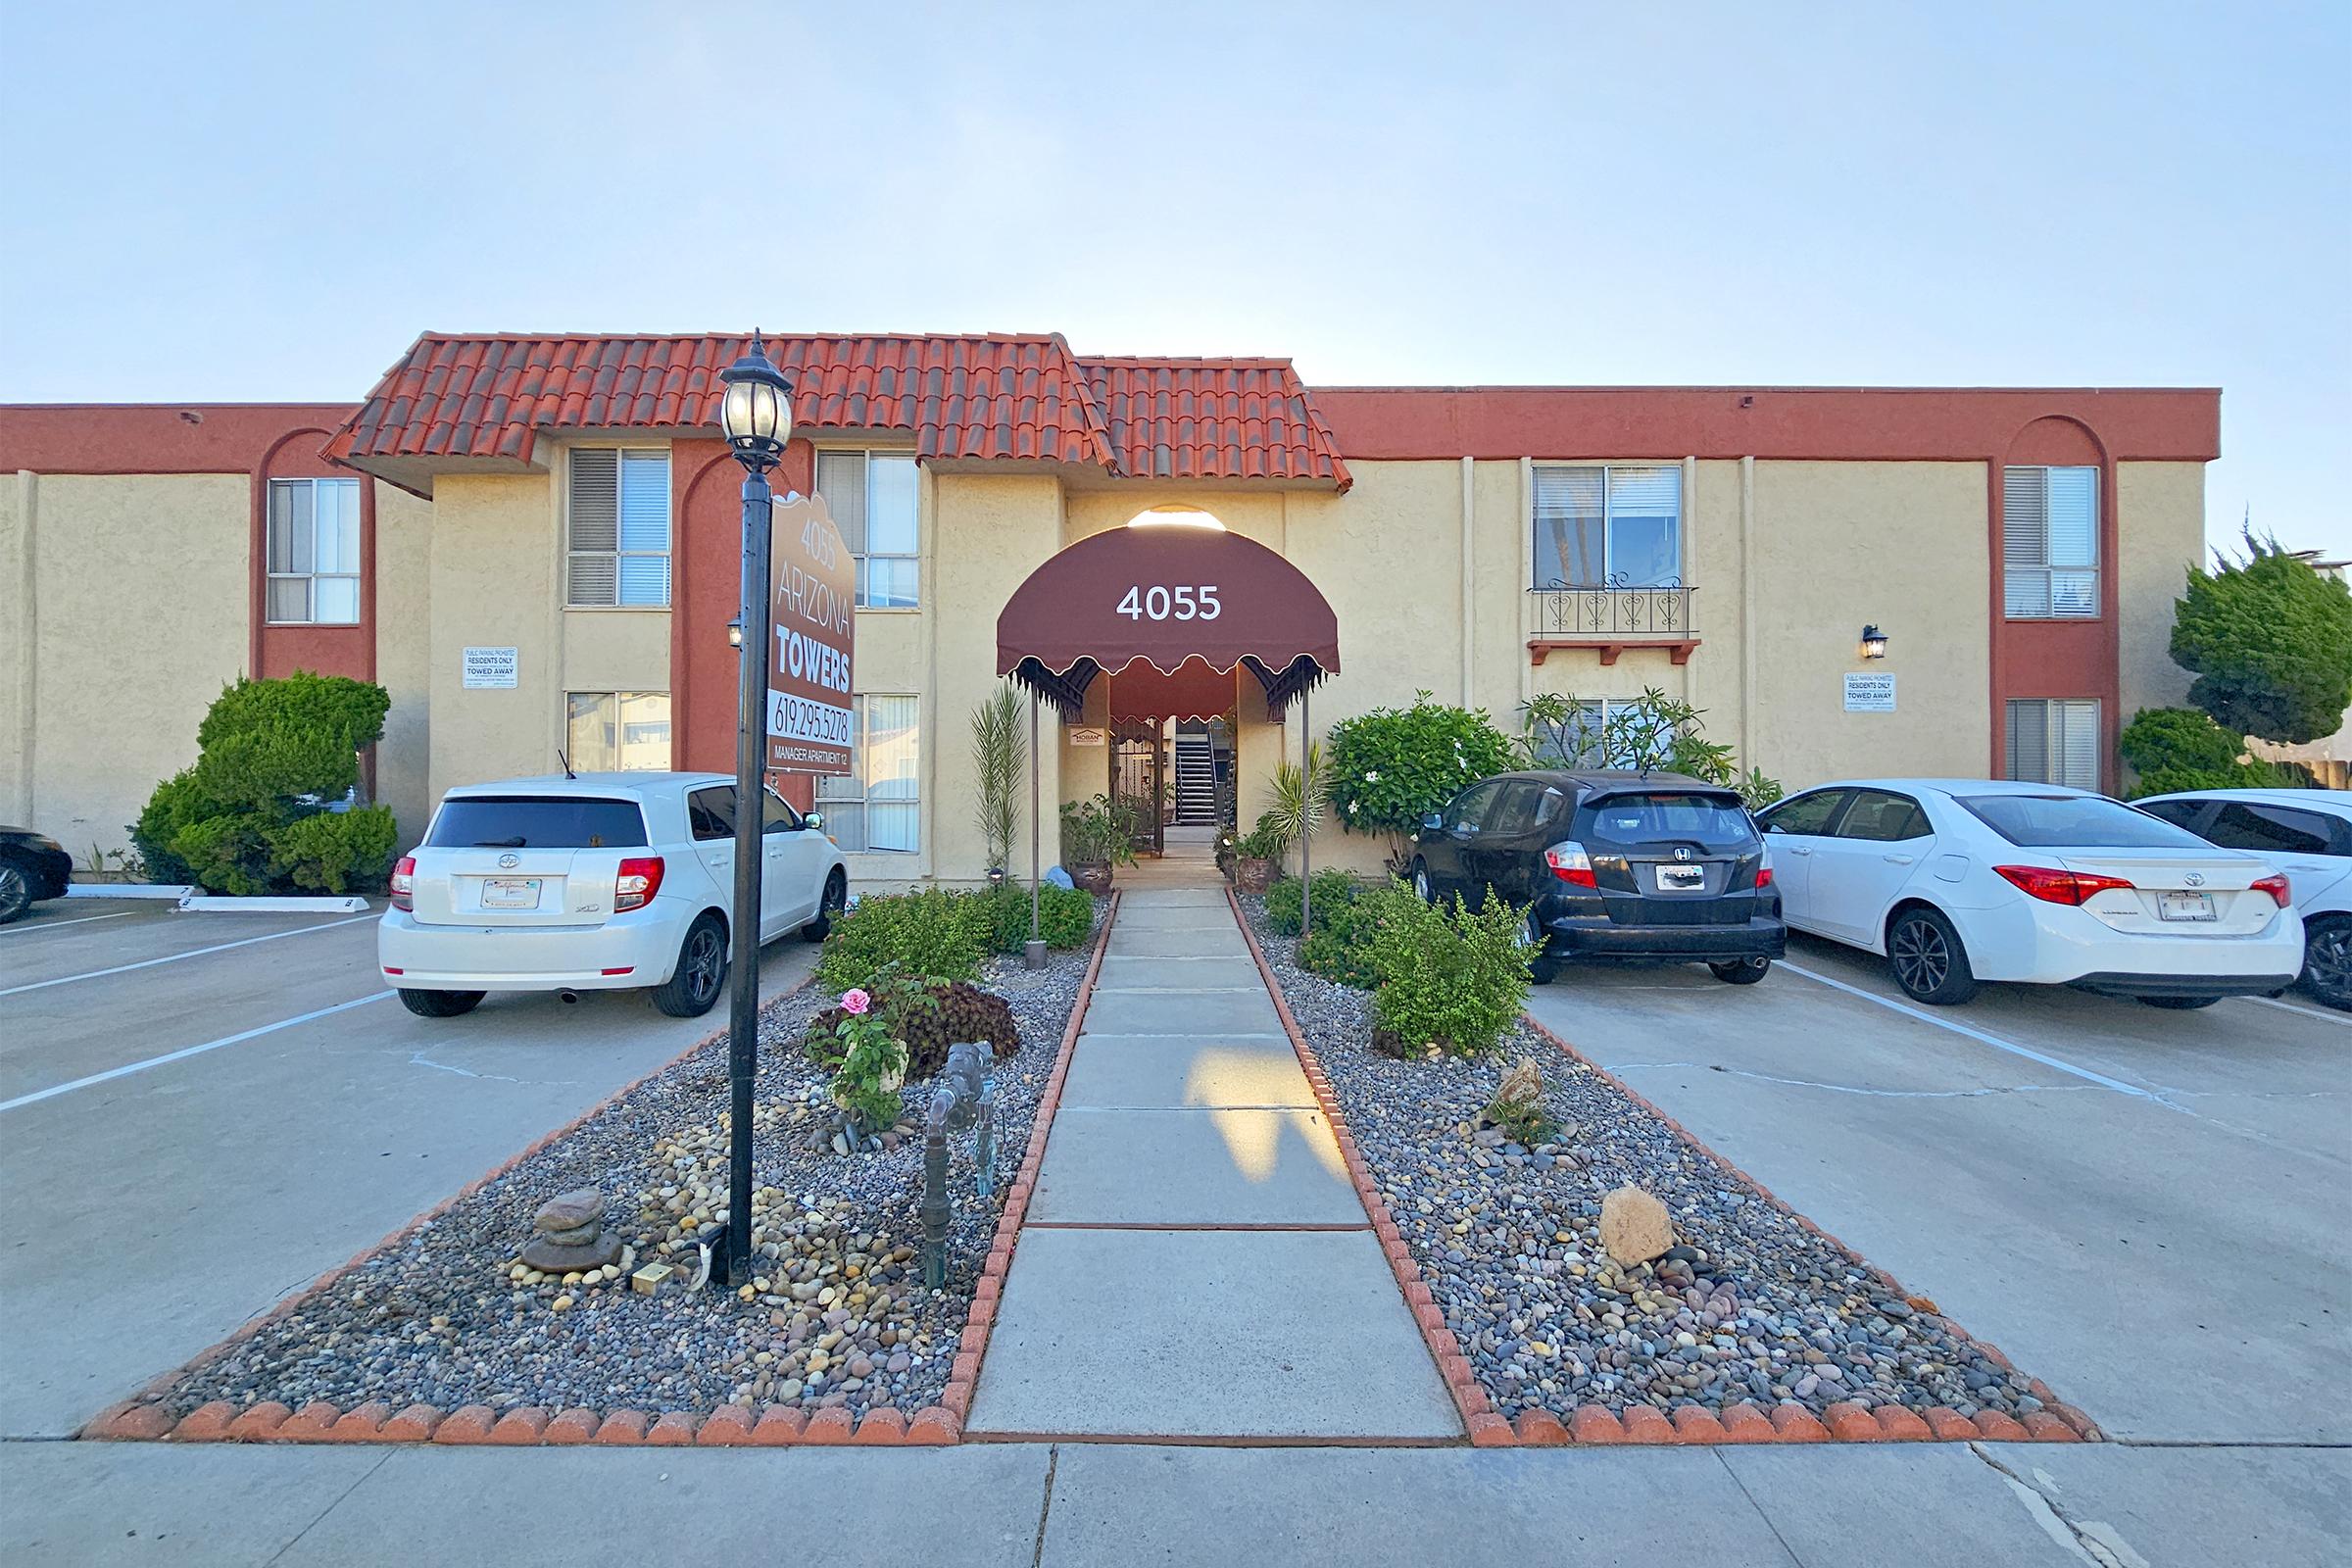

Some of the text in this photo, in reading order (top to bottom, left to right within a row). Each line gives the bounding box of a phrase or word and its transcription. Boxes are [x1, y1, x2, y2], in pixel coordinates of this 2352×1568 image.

[801, 518, 836, 572] 4055
[776, 560, 851, 640] ARIZONA
[1116, 585, 1222, 621] 4055
[776, 622, 851, 695] TOWERS
[774, 696, 849, 743] 619.295.5278
[774, 744, 807, 761] MANAGER
[808, 748, 841, 764] APARTMENT
